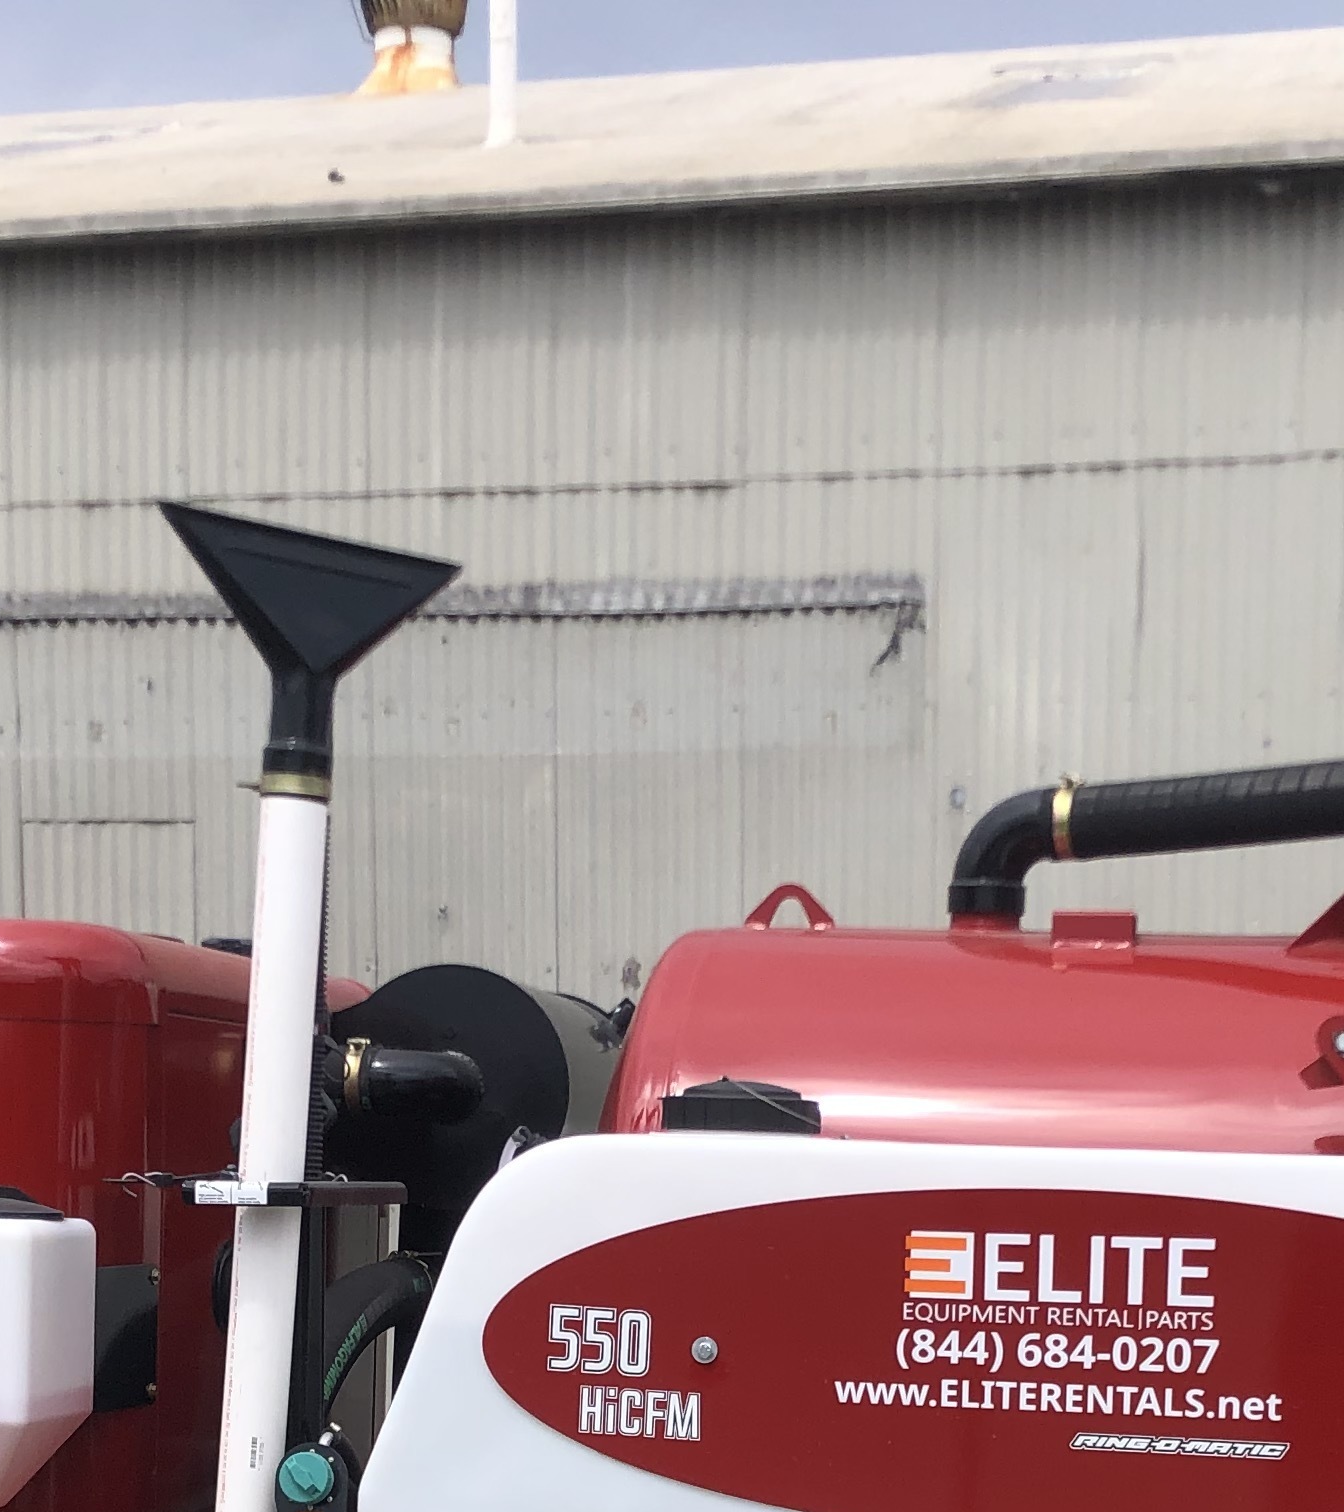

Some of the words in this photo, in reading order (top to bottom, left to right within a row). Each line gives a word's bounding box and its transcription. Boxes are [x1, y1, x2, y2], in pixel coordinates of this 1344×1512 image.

[983, 1232, 1216, 1307] ELITE
[902, 1302, 1040, 1325] EQUIPMENT
[547, 1303, 652, 1377] 550
[896, 1328, 1004, 1373] (844)
[1017, 1333, 1220, 1374] 684-0207
[578, 1385, 701, 1442] HiCFM
[834, 1378, 1283, 1422] www.ELITERENTALS.net
[1072, 1432, 1289, 1460] RING-O-MATIC
